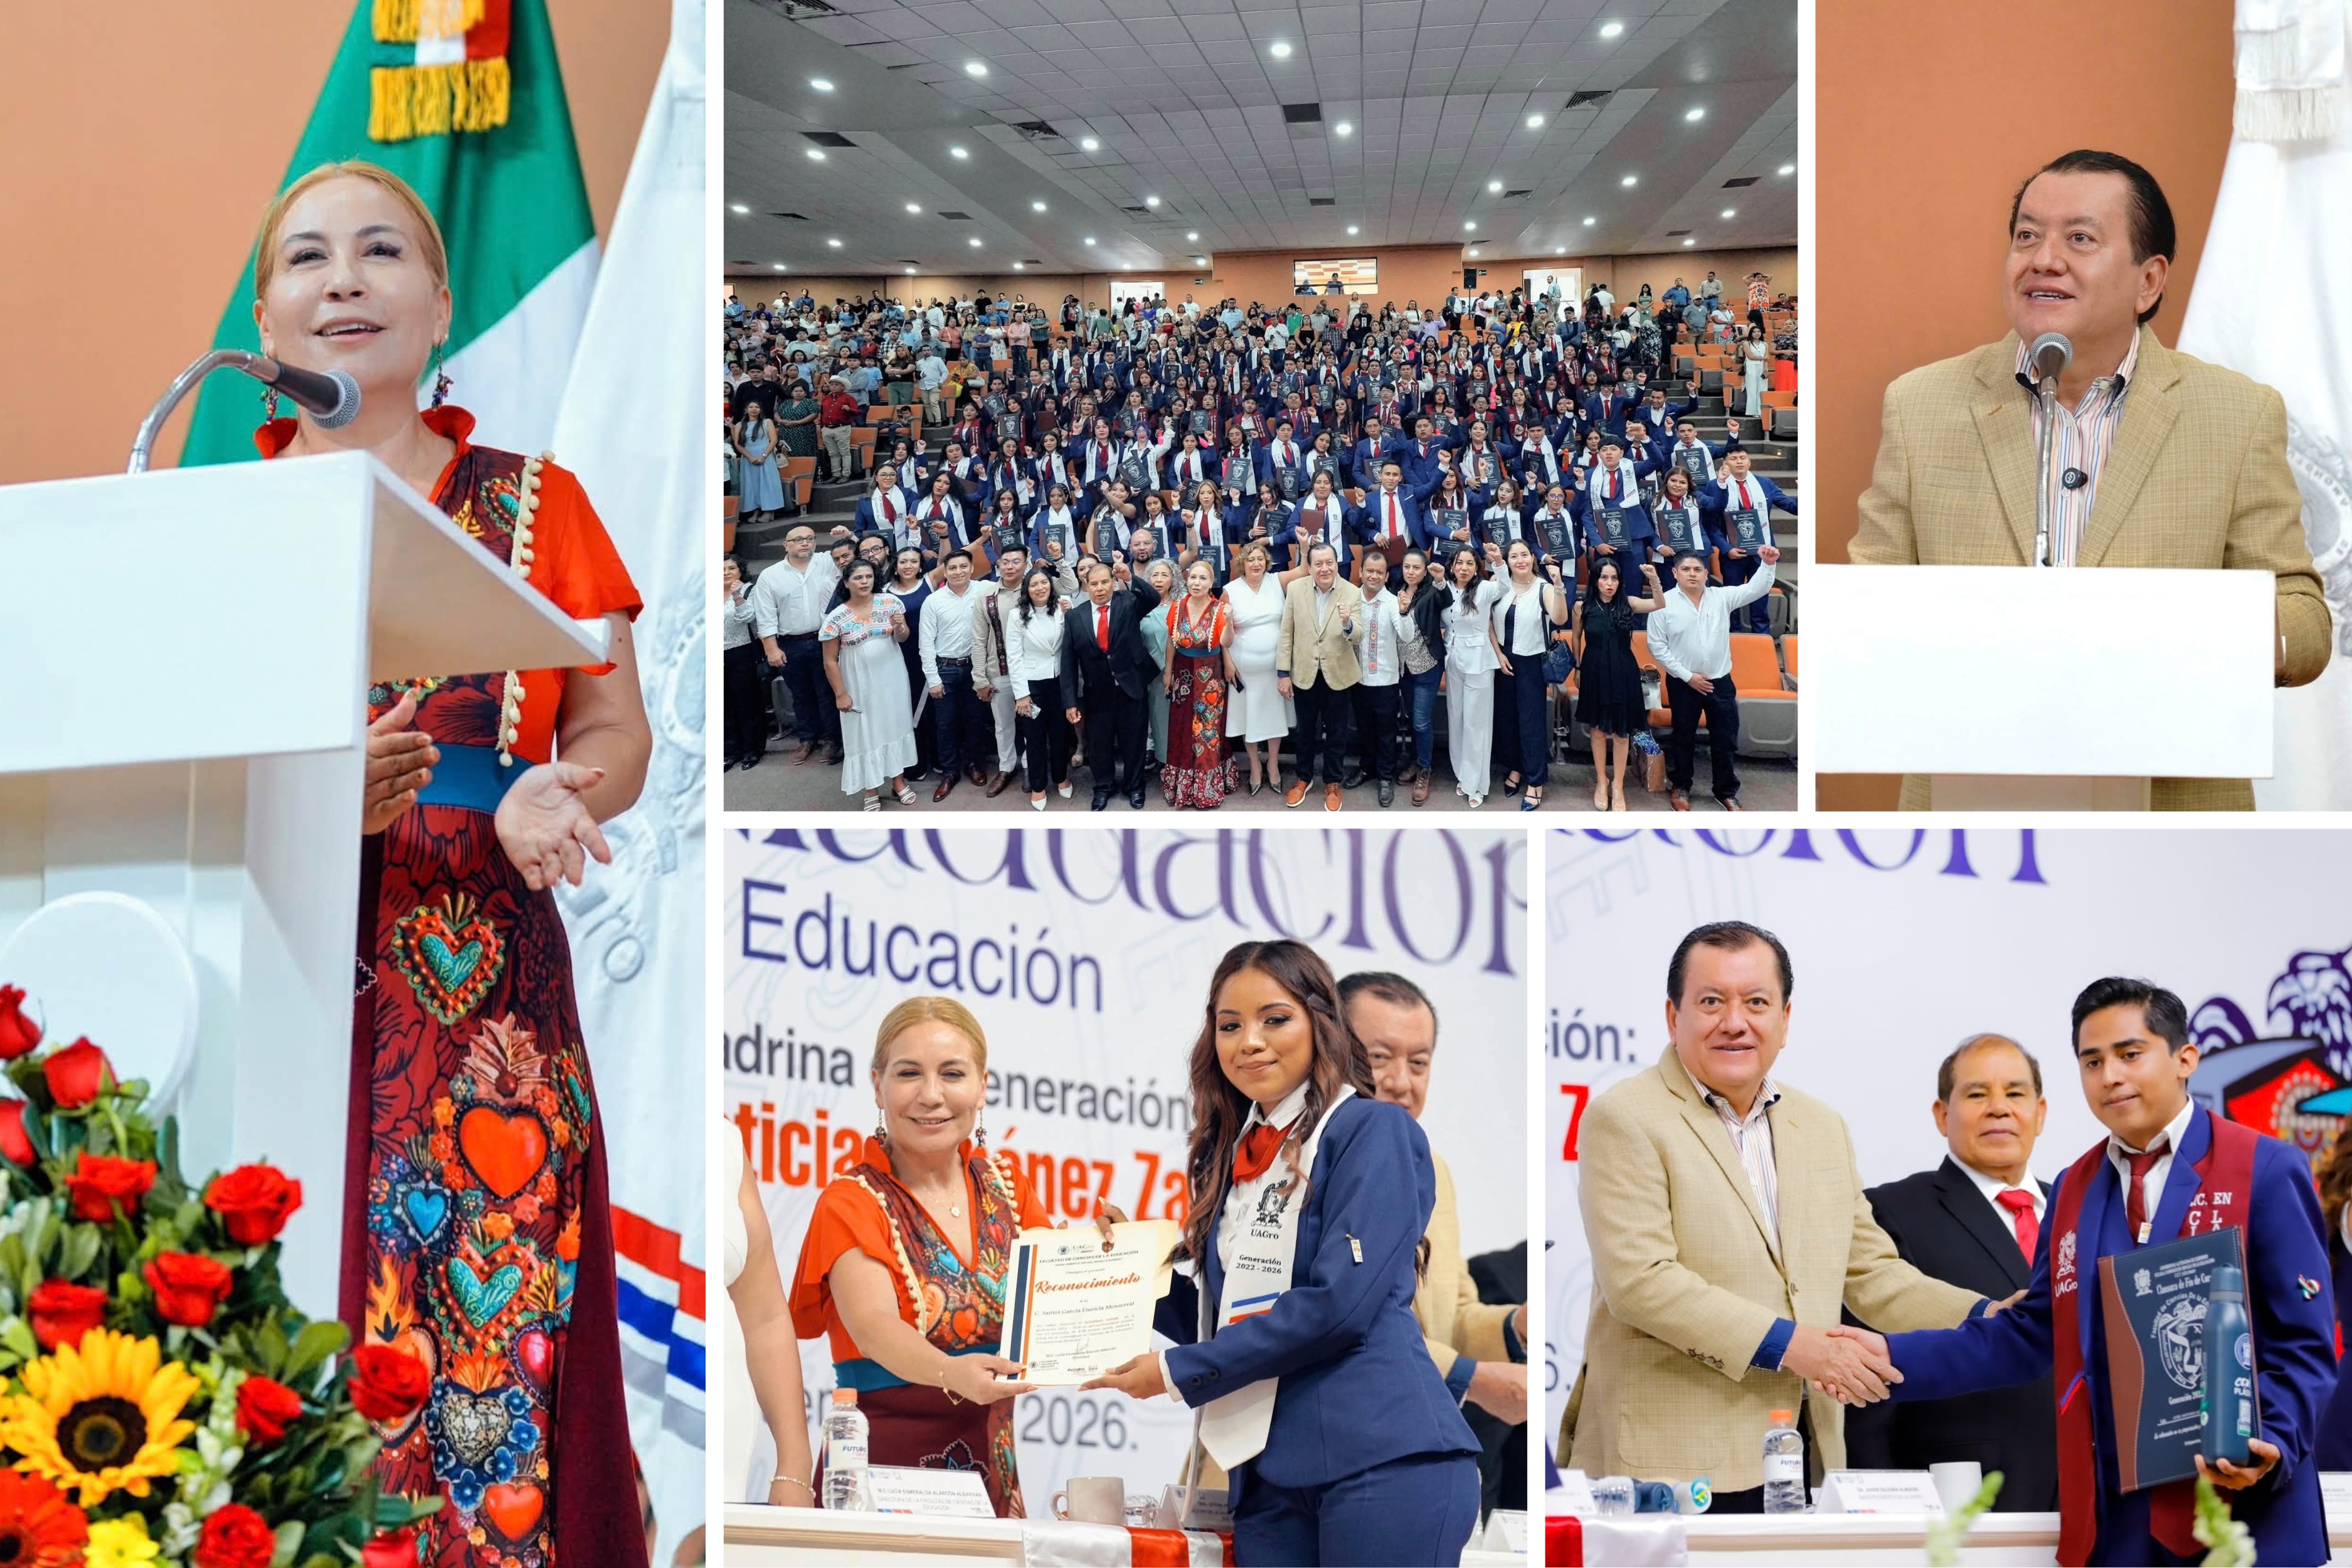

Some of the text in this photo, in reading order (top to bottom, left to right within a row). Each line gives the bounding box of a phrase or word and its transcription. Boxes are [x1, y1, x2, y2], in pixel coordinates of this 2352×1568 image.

[741, 878, 1102, 1012] Educación
[1545, 1008, 1635, 1062] ión:
[985, 1069, 1189, 1130] eneración
[725, 1102, 864, 1189] ticia
[2212, 1192, 2232, 1205] EN
[1251, 1229, 1279, 1239] UAGro
[1236, 1263, 1255, 1271] 2022
[1239, 1254, 1281, 1266] Generación
[1036, 1272, 1142, 1294] Reconocimiento
[2055, 1278, 2078, 1297] UAGro
[1022, 1394, 1138, 1450] 2026.
